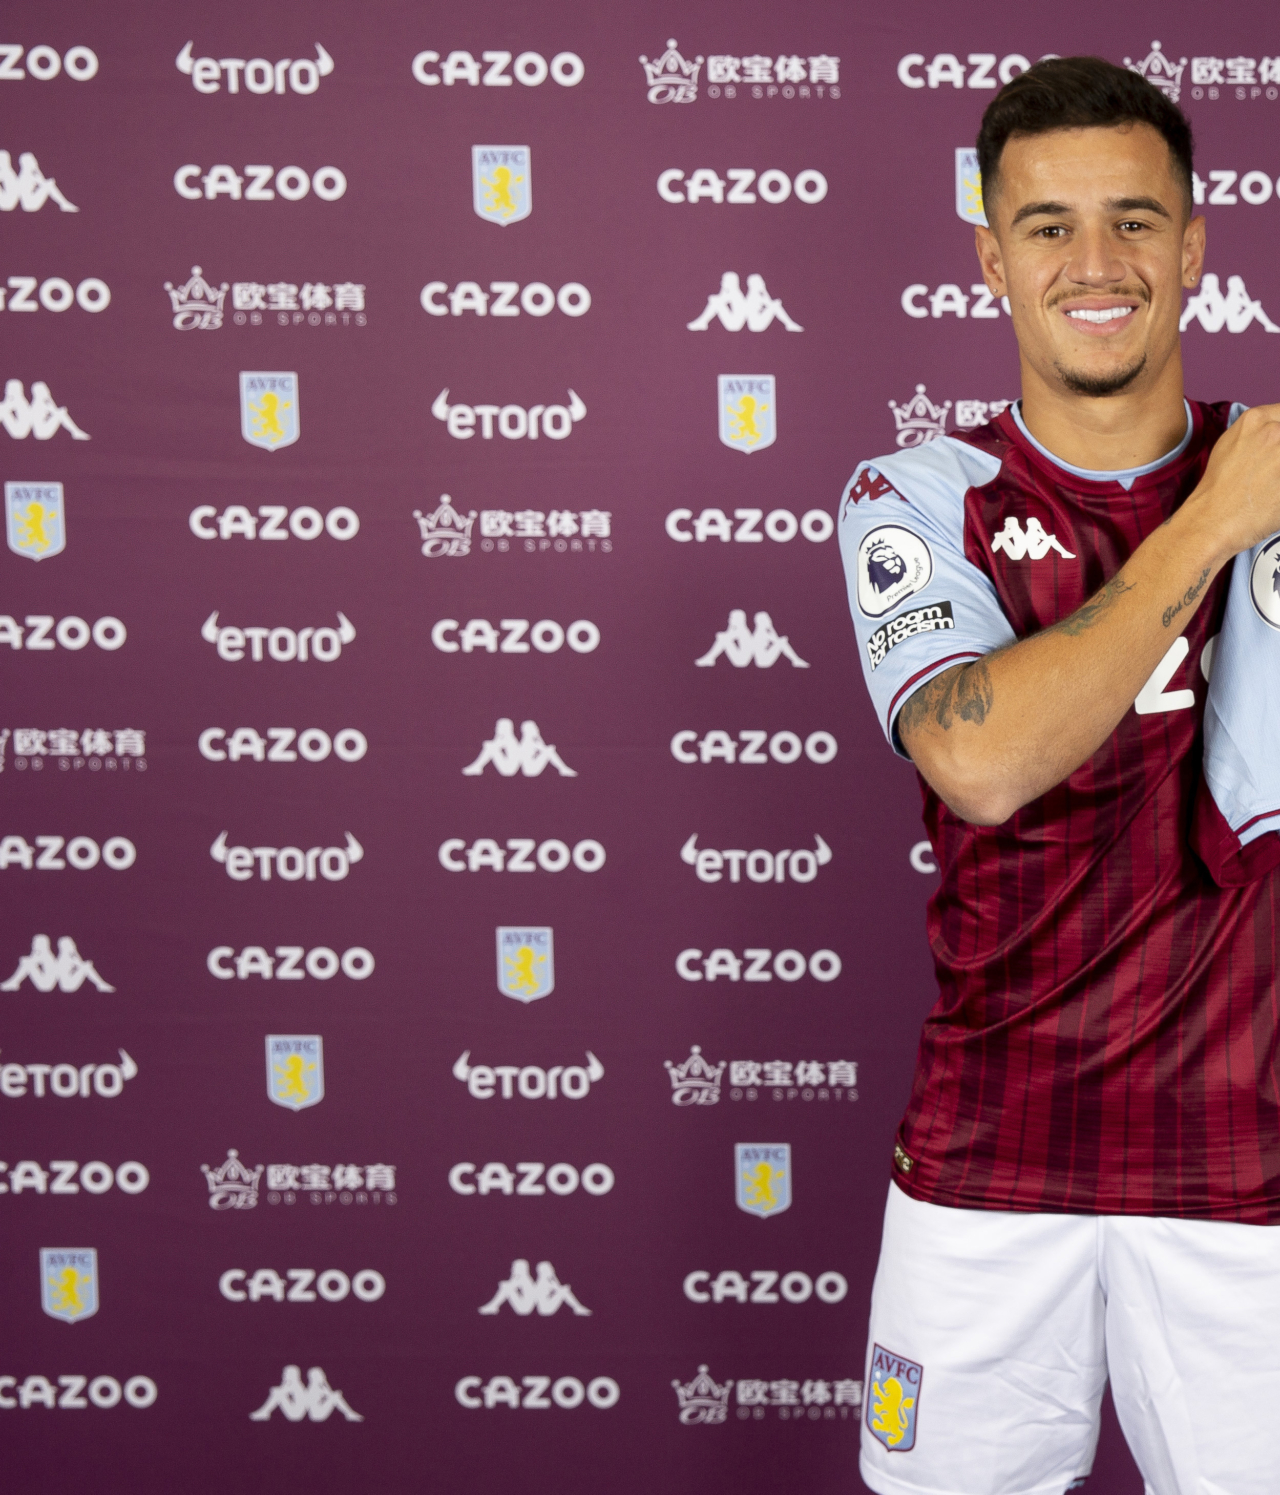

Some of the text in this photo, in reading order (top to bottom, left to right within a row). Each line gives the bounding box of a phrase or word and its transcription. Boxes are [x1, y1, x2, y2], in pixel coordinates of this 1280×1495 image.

[0, 45, 98, 81] ZOO
[412, 51, 584, 86] CAZOO
[898, 54, 1062, 88] CAZO
[174, 165, 346, 200] CAZOO
[657, 169, 827, 203] CAZOO
[0, 277, 110, 312] ZOO
[421, 282, 591, 316] CAZOO
[901, 284, 1011, 318] CAZ
[190, 506, 359, 540] CAZOO
[666, 509, 834, 542] CAZOO
[0, 616, 126, 650] AZOO
[432, 619, 600, 653] CAZOO
[867, 606, 942, 652] No room
[869, 617, 954, 671] for racism
[199, 728, 367, 761] CAZOO
[671, 730, 837, 763] CAZOO
[0, 836, 136, 869] AZOO
[439, 839, 605, 872] CAZOO
[208, 947, 374, 979] CAZOO
[676, 949, 841, 981] CAZOO
[449, 1163, 614, 1195] CAZOO
[220, 1269, 385, 1301] CAZOO
[684, 1271, 847, 1303] CAZOO
[874, 1352, 919, 1385] AVFC
[0, 1376, 157, 1408] CAZOO
[455, 1376, 619, 1408] CAZOO
